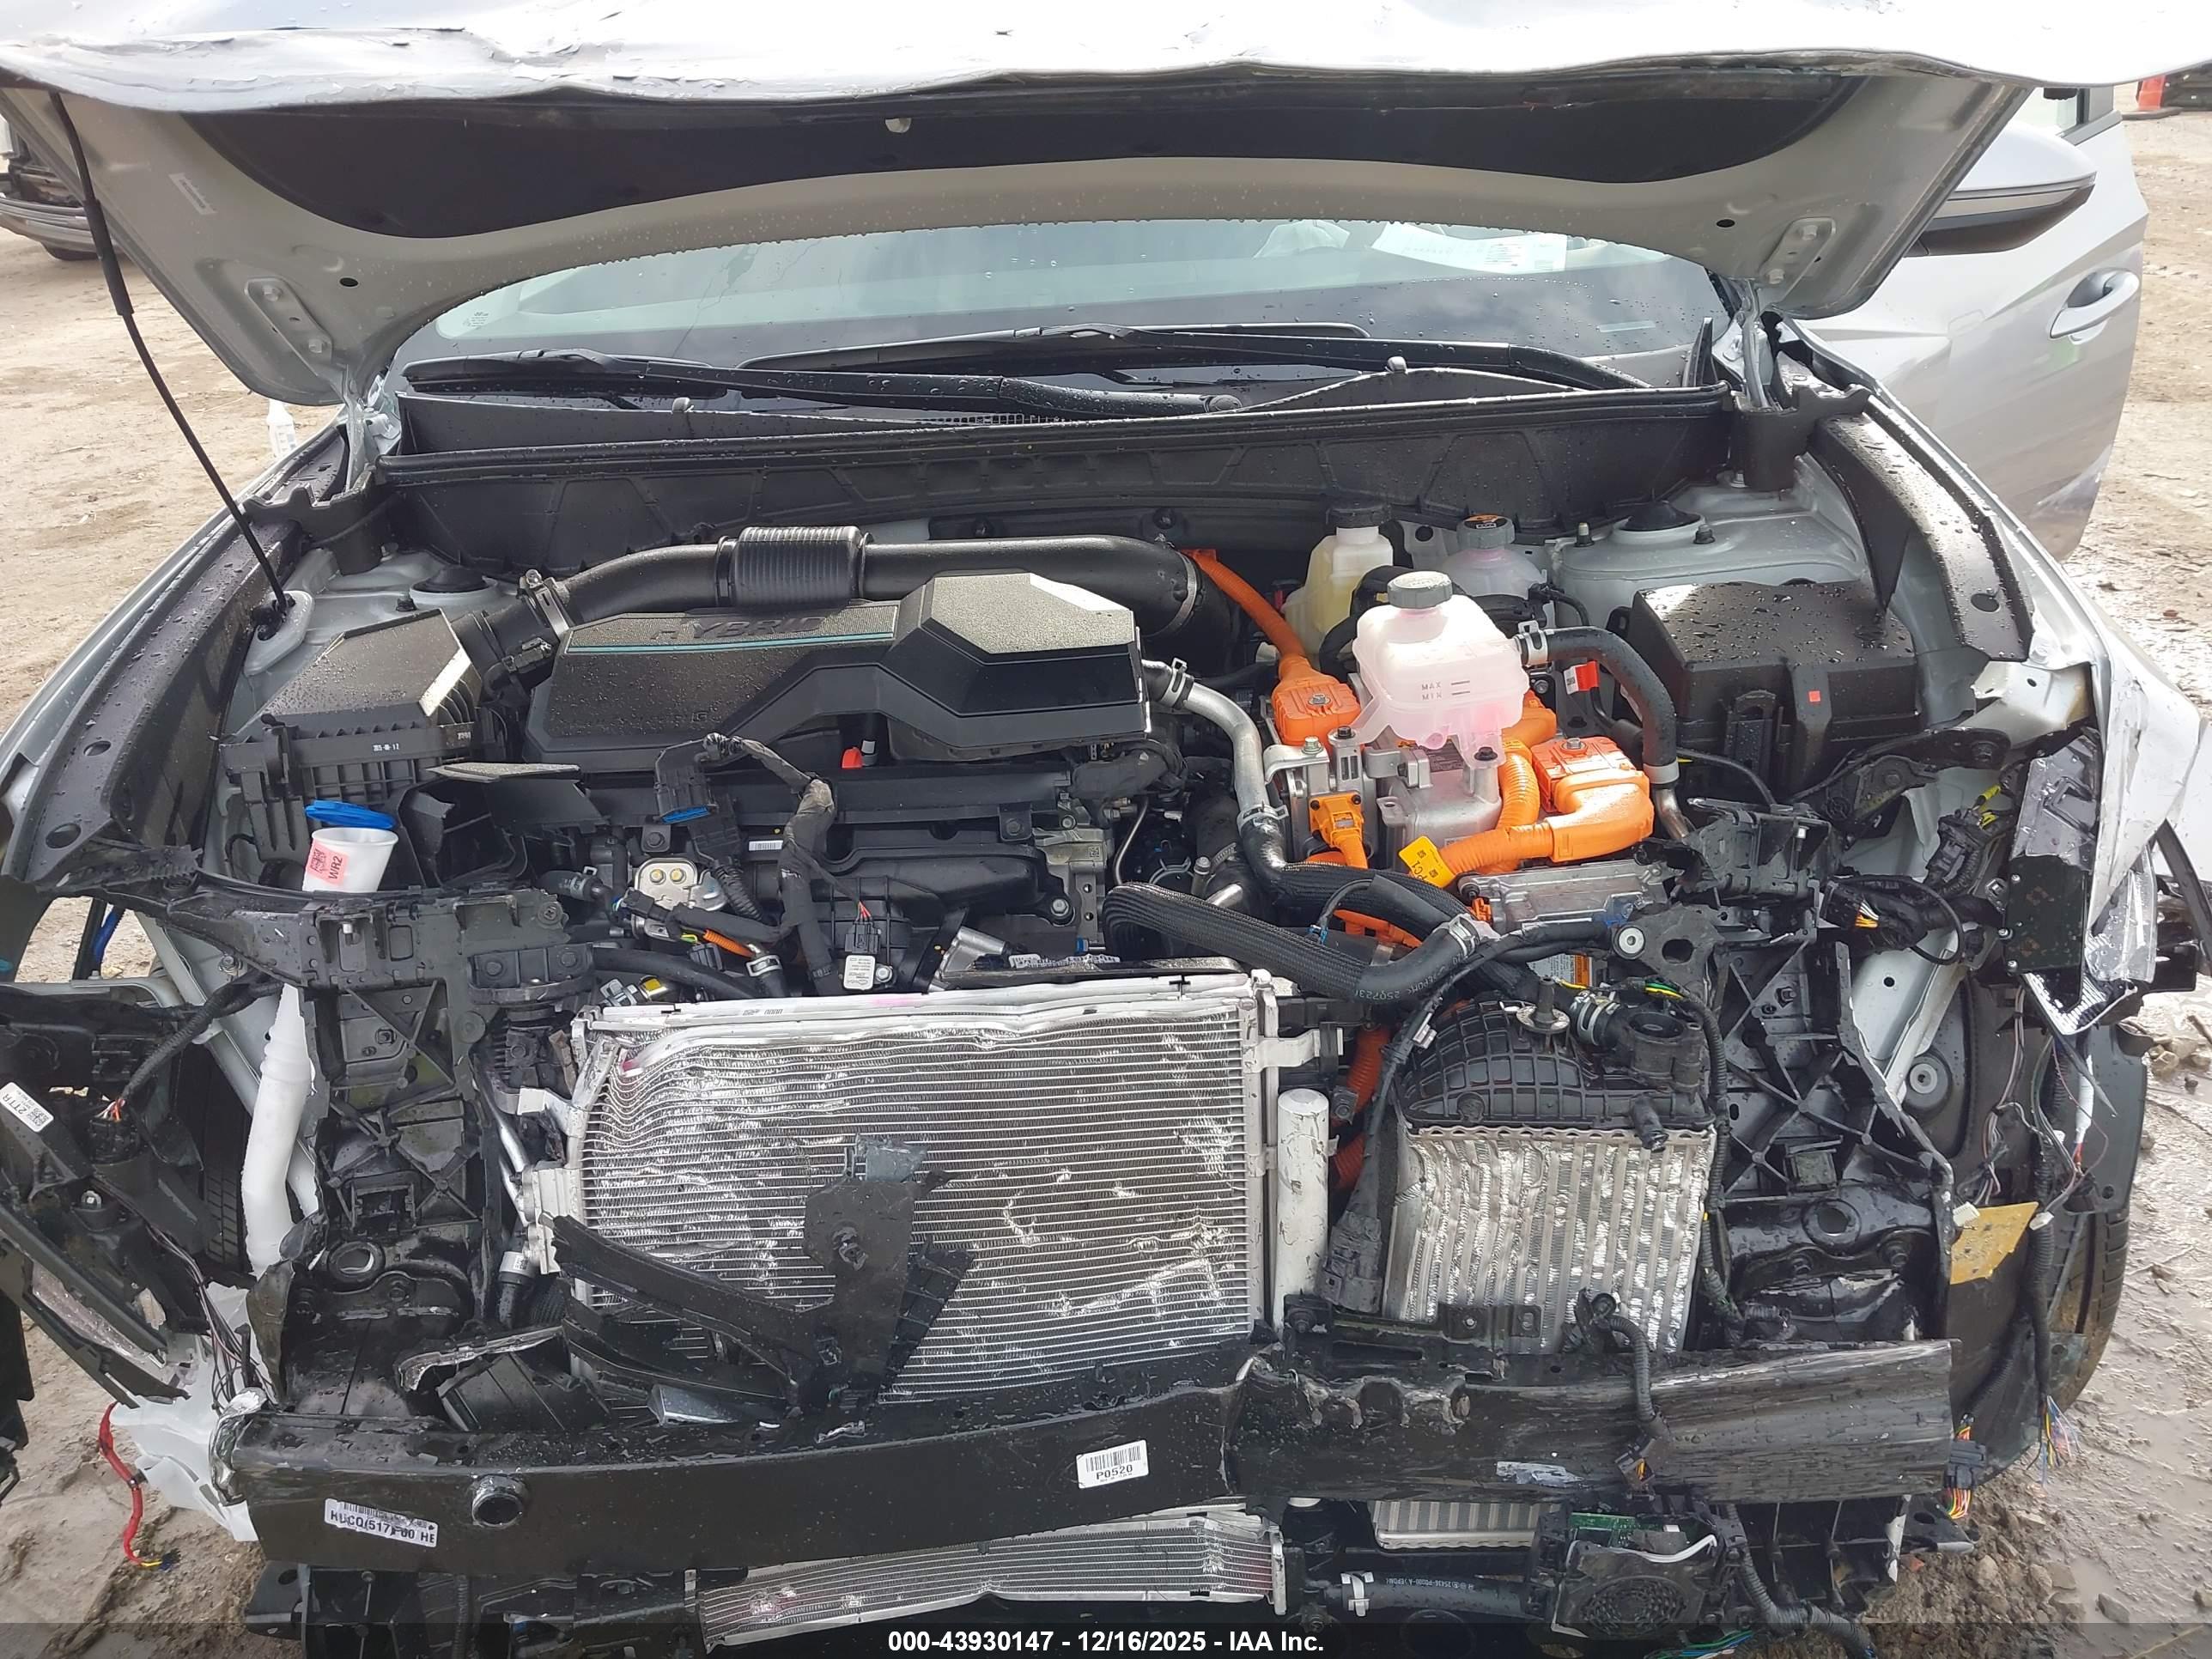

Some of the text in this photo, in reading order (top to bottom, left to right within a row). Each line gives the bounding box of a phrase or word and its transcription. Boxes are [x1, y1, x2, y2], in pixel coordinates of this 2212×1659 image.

[1421, 681, 1442, 691] MAX
[1422, 691, 1443, 701] MIN
[328, 855, 343, 879] WR2
[2, 1093, 27, 1115] 2TTR
[1096, 1464, 1133, 1480] P0520
[420, 1532, 435, 1544] HE
